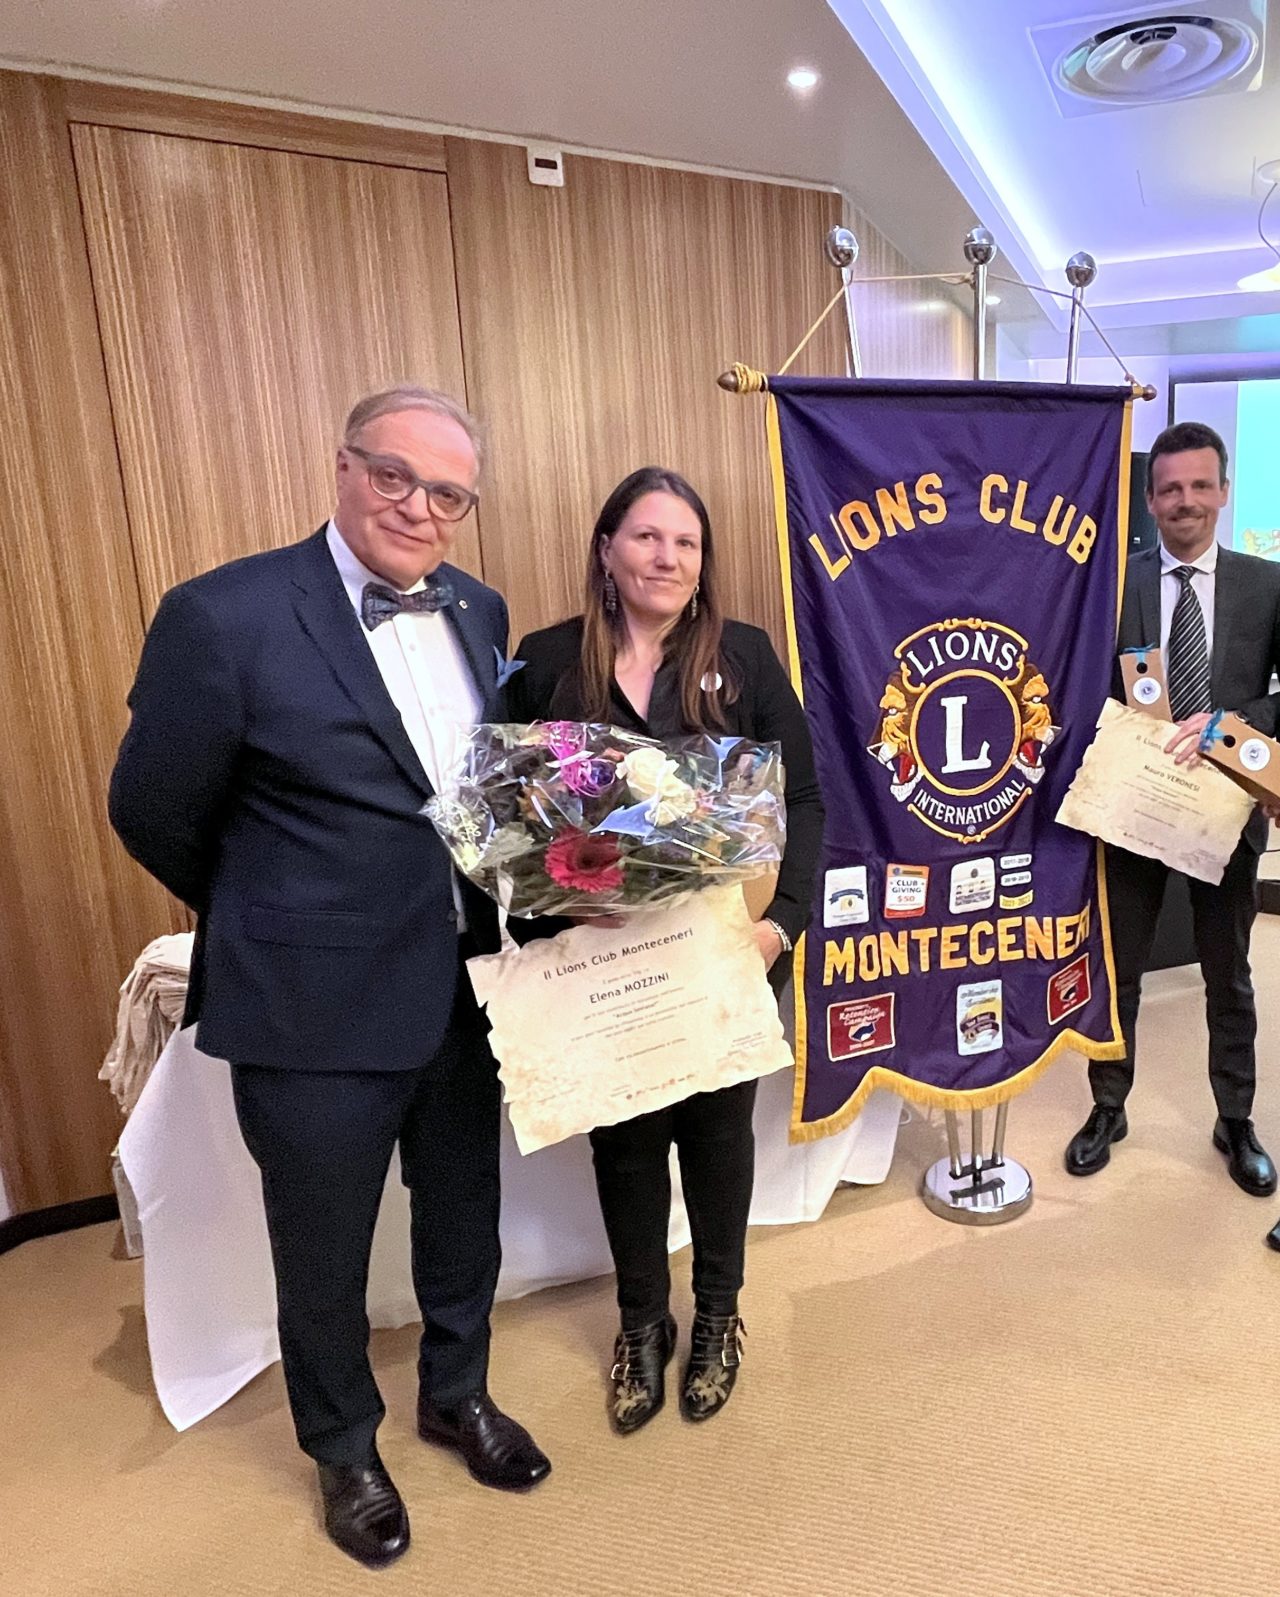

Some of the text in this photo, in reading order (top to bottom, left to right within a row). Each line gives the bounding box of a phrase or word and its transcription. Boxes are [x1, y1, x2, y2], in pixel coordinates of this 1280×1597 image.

[808, 472, 1097, 581] LIONS CLUB
[906, 631, 1018, 677] LIONS
[940, 695, 992, 774] L
[913, 779, 1025, 825] INTERNATIONAL
[1167, 774, 1201, 792] VERONESI
[891, 886, 922, 894] GIVING
[896, 879, 919, 887] CLUB
[556, 960, 587, 977] Lions
[591, 951, 617, 966] Club
[622, 927, 693, 957] Monteceneri
[589, 988, 621, 1004] Elena
[624, 972, 669, 994] MOZZINI
